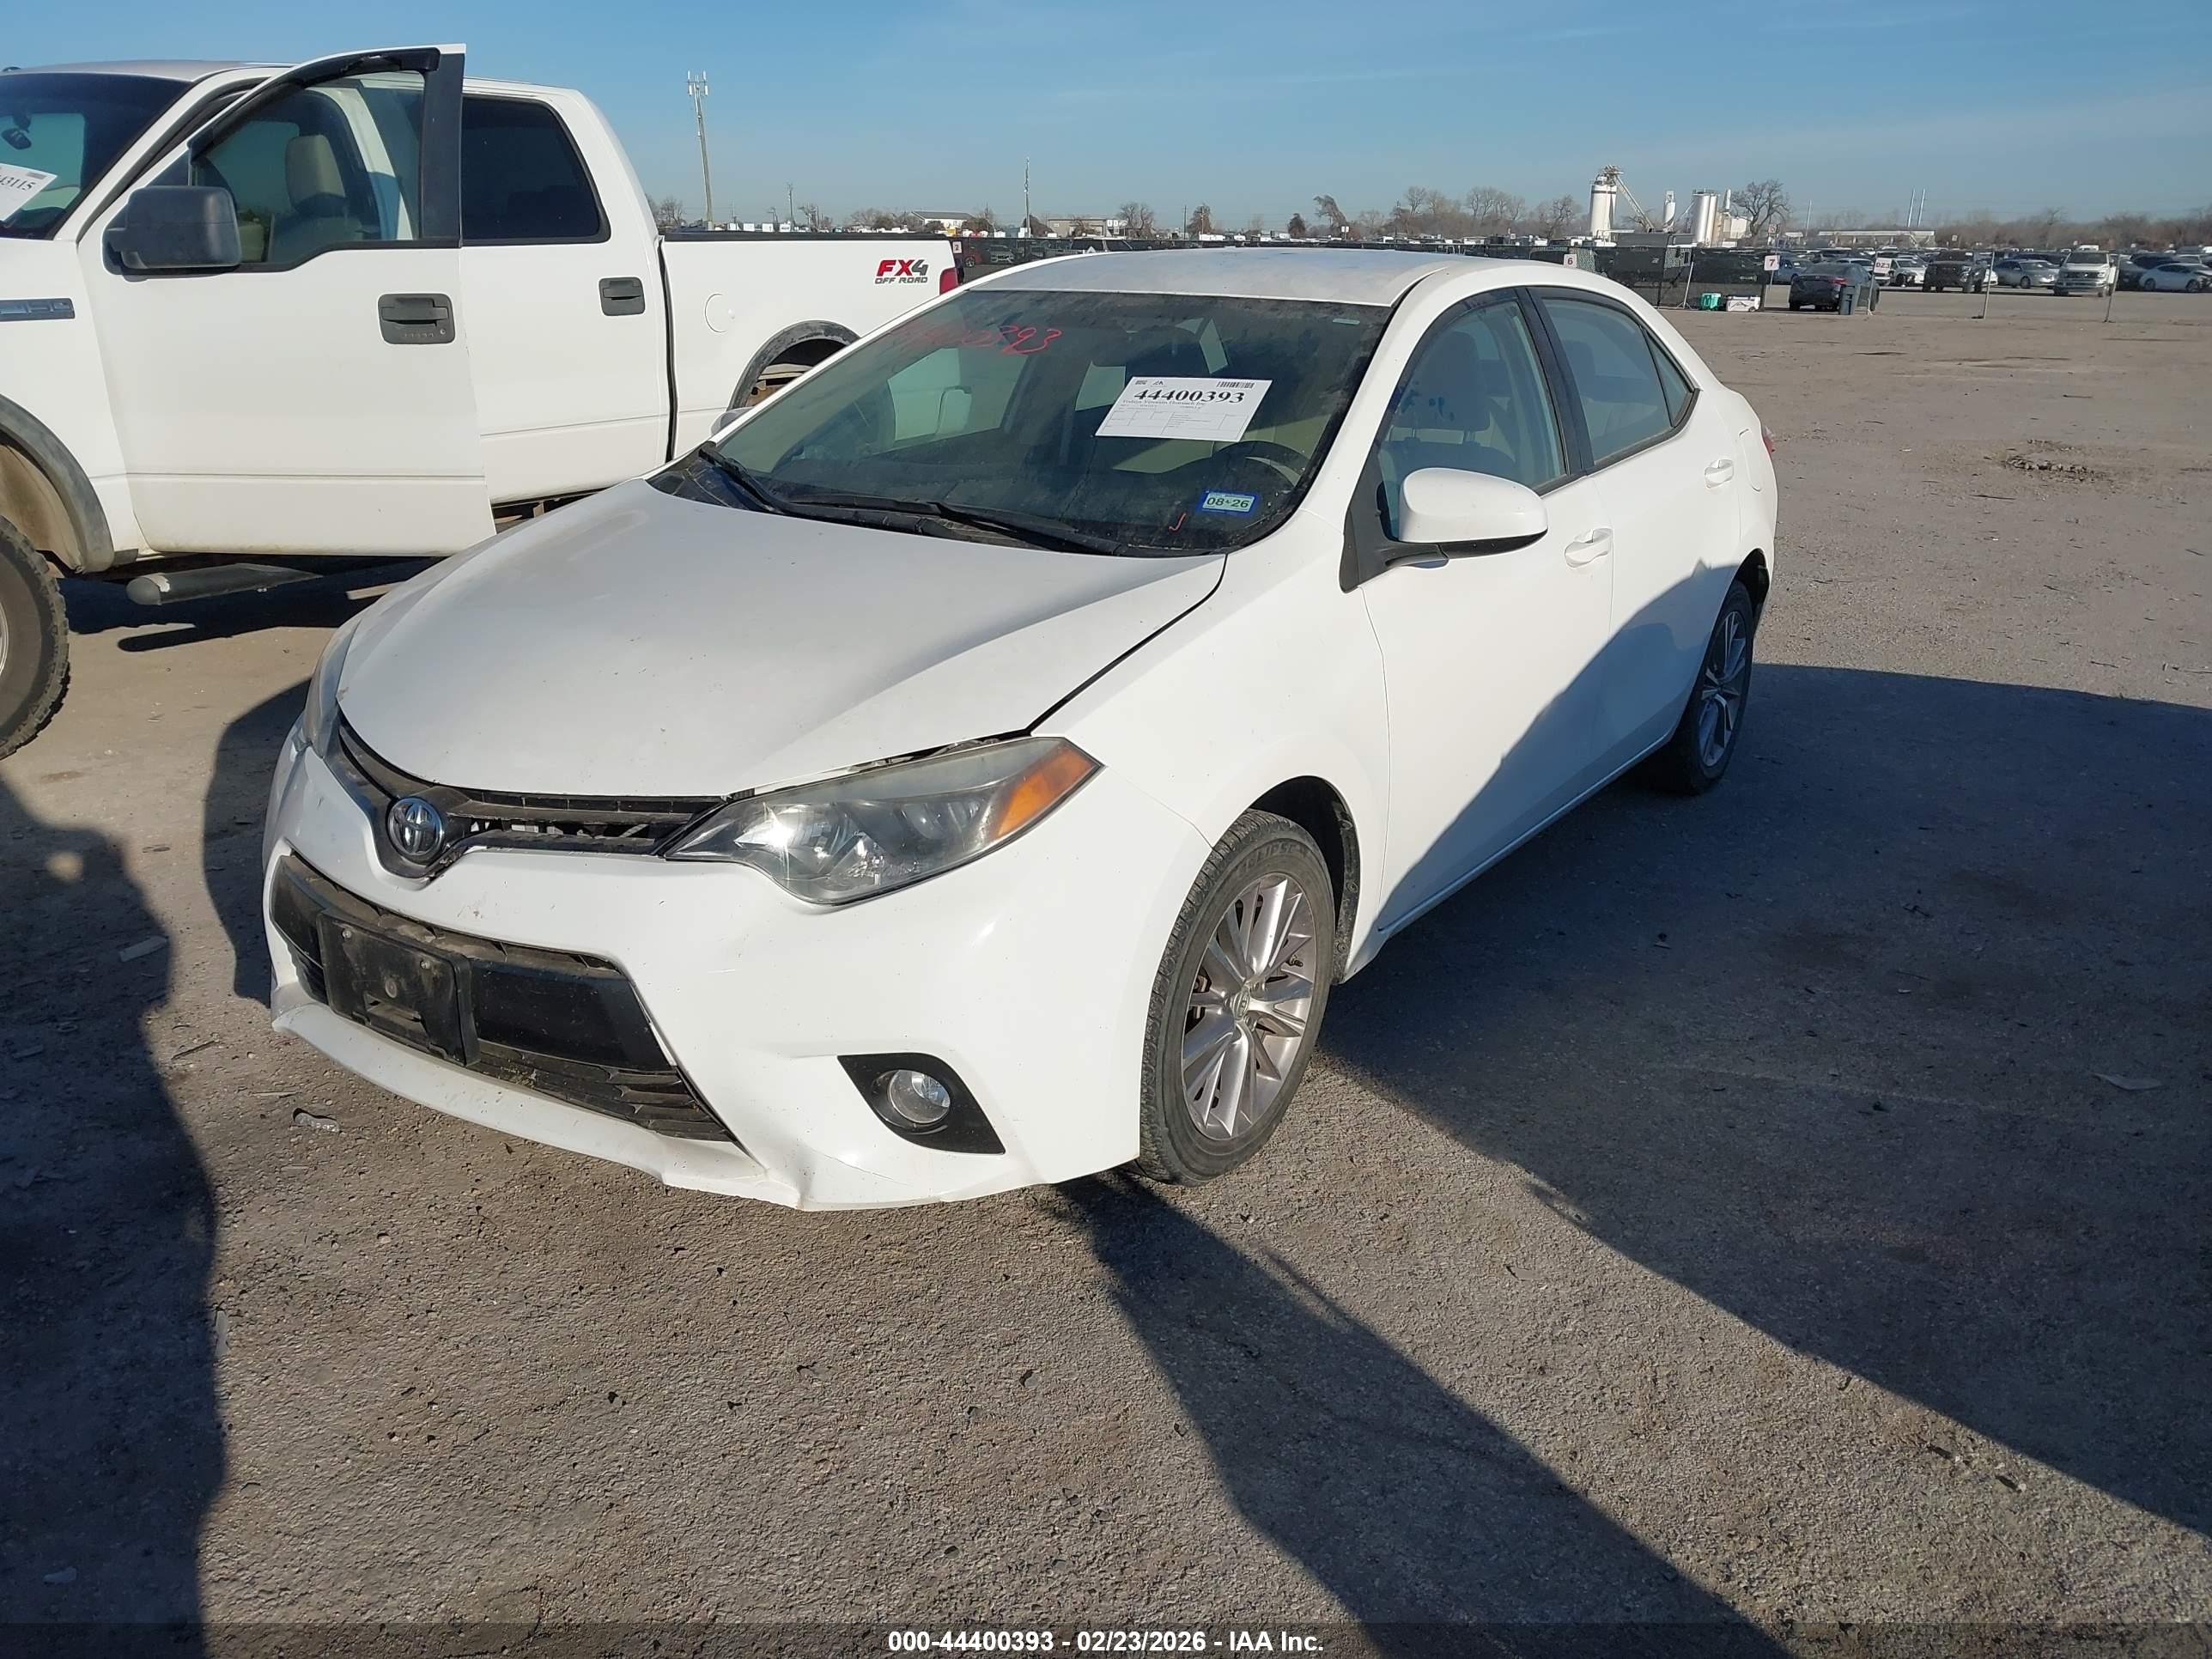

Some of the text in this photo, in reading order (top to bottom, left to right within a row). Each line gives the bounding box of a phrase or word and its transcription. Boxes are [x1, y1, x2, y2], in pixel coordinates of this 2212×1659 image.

[877, 259, 928, 276] FX4
[1769, 258, 1776, 267] 7
[1133, 389, 1245, 404] 44400393
